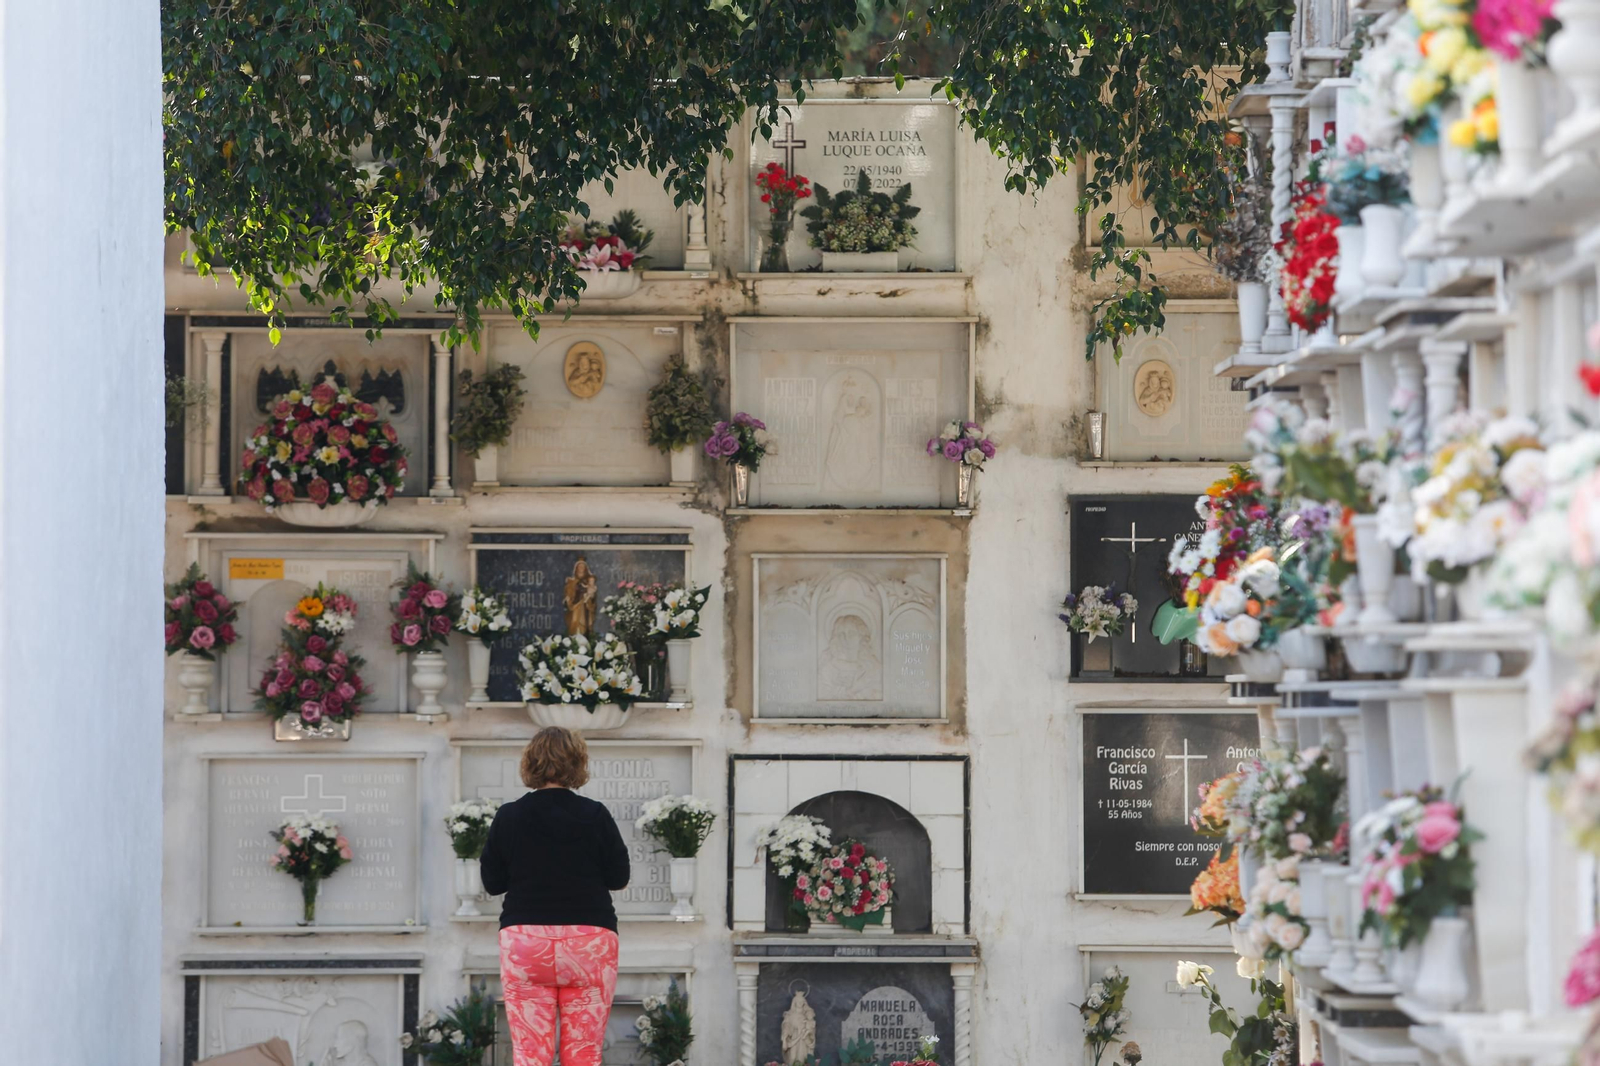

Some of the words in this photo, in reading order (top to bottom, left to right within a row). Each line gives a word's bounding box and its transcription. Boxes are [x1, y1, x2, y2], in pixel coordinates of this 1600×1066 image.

[828, 127, 875, 142] MARÍA
[880, 130, 922, 142] LUISA
[823, 145, 871, 158] LUQUE
[875, 143, 926, 156] OCAÑA
[843, 178, 901, 188] 07//2022
[1173, 532, 1203, 542] CAÑE
[1097, 746, 1155, 758] Francisco
[588, 758, 655, 778] NTONIA
[1108, 760, 1147, 774] García
[1109, 777, 1143, 790] Rivas
[600, 781, 670, 799] INFANTE
[1106, 799, 1153, 809] 11-05-1984
[1108, 811, 1119, 819] 55
[1121, 810, 1142, 819] Años
[1135, 841, 1175, 851] Siempre
[1177, 842, 1194, 851] con
[1175, 857, 1199, 866] D.E.P.
[622, 887, 675, 903] OLVIDA
[860, 1000, 916, 1012] MANUELA
[873, 1014, 904, 1026] ROCA
[857, 1027, 919, 1039] ANDRADES
